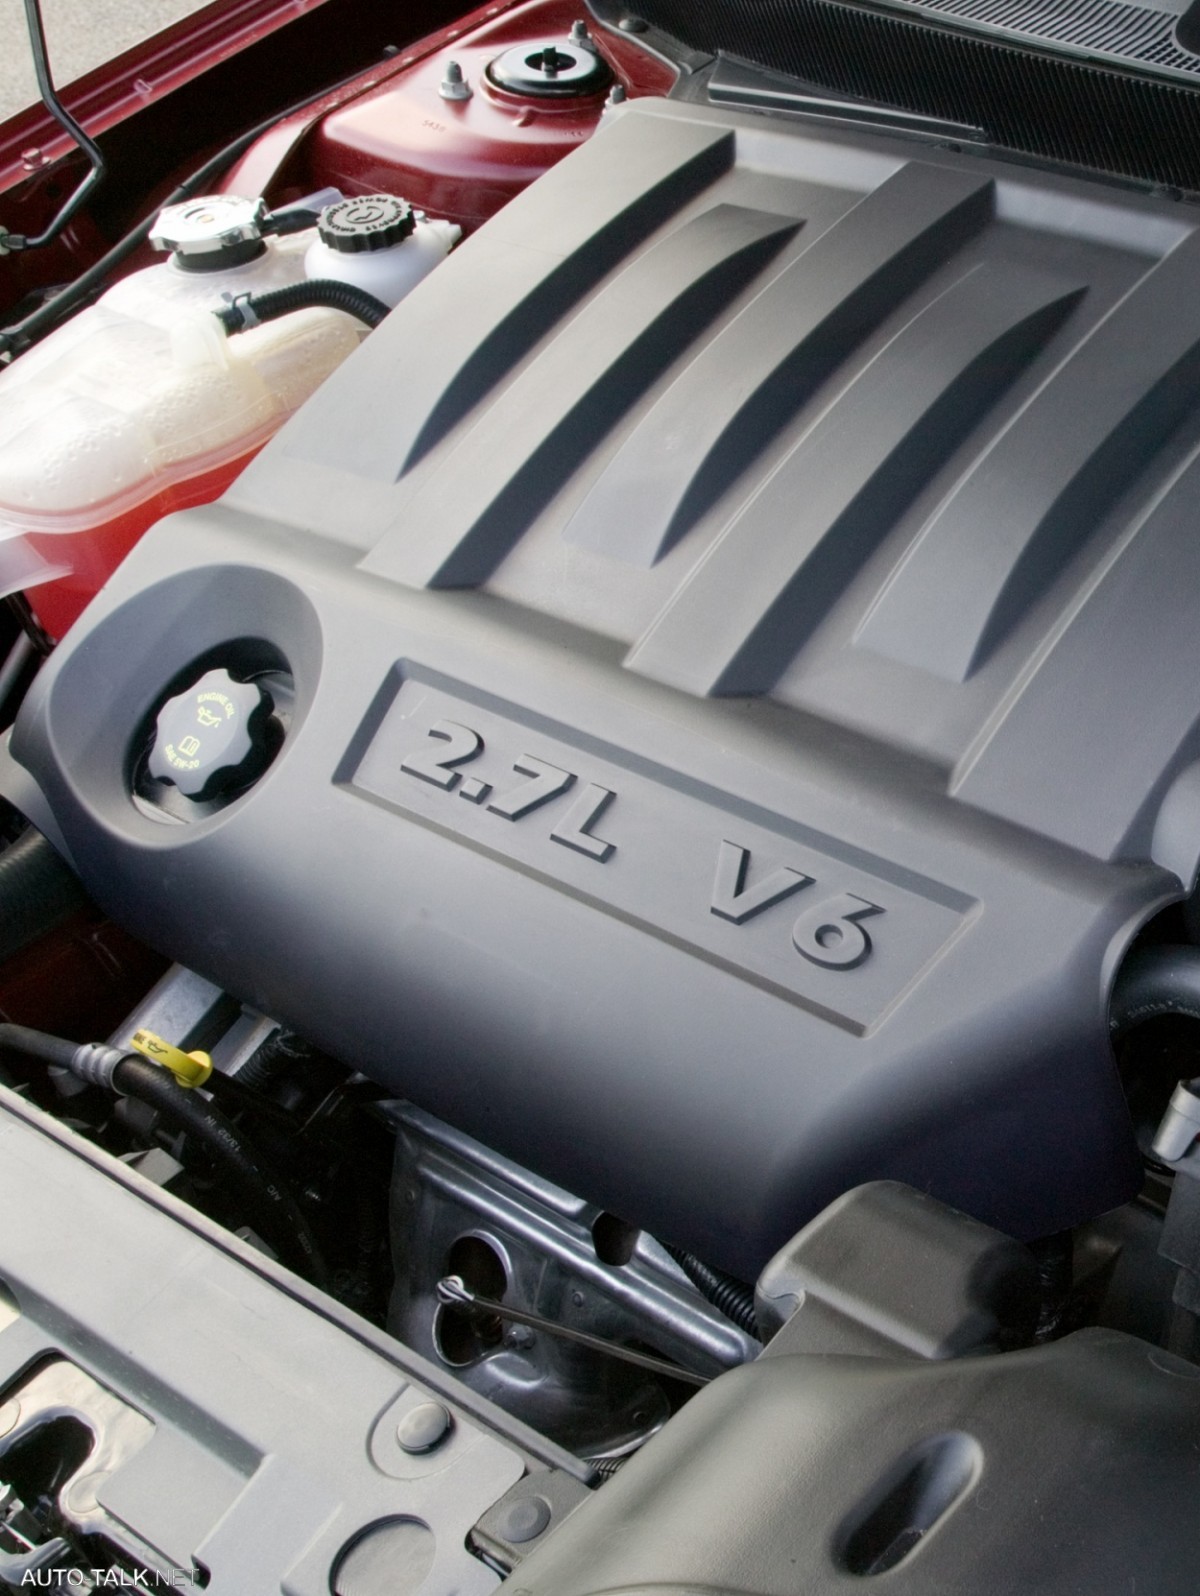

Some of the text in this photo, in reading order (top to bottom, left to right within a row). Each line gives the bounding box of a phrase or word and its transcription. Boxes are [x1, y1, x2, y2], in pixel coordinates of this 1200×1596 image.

[197, 691, 236, 720] ENGINE OIL
[174, 758, 201, 770] 5W-20
[400, 718, 887, 972] 2.7L V6
